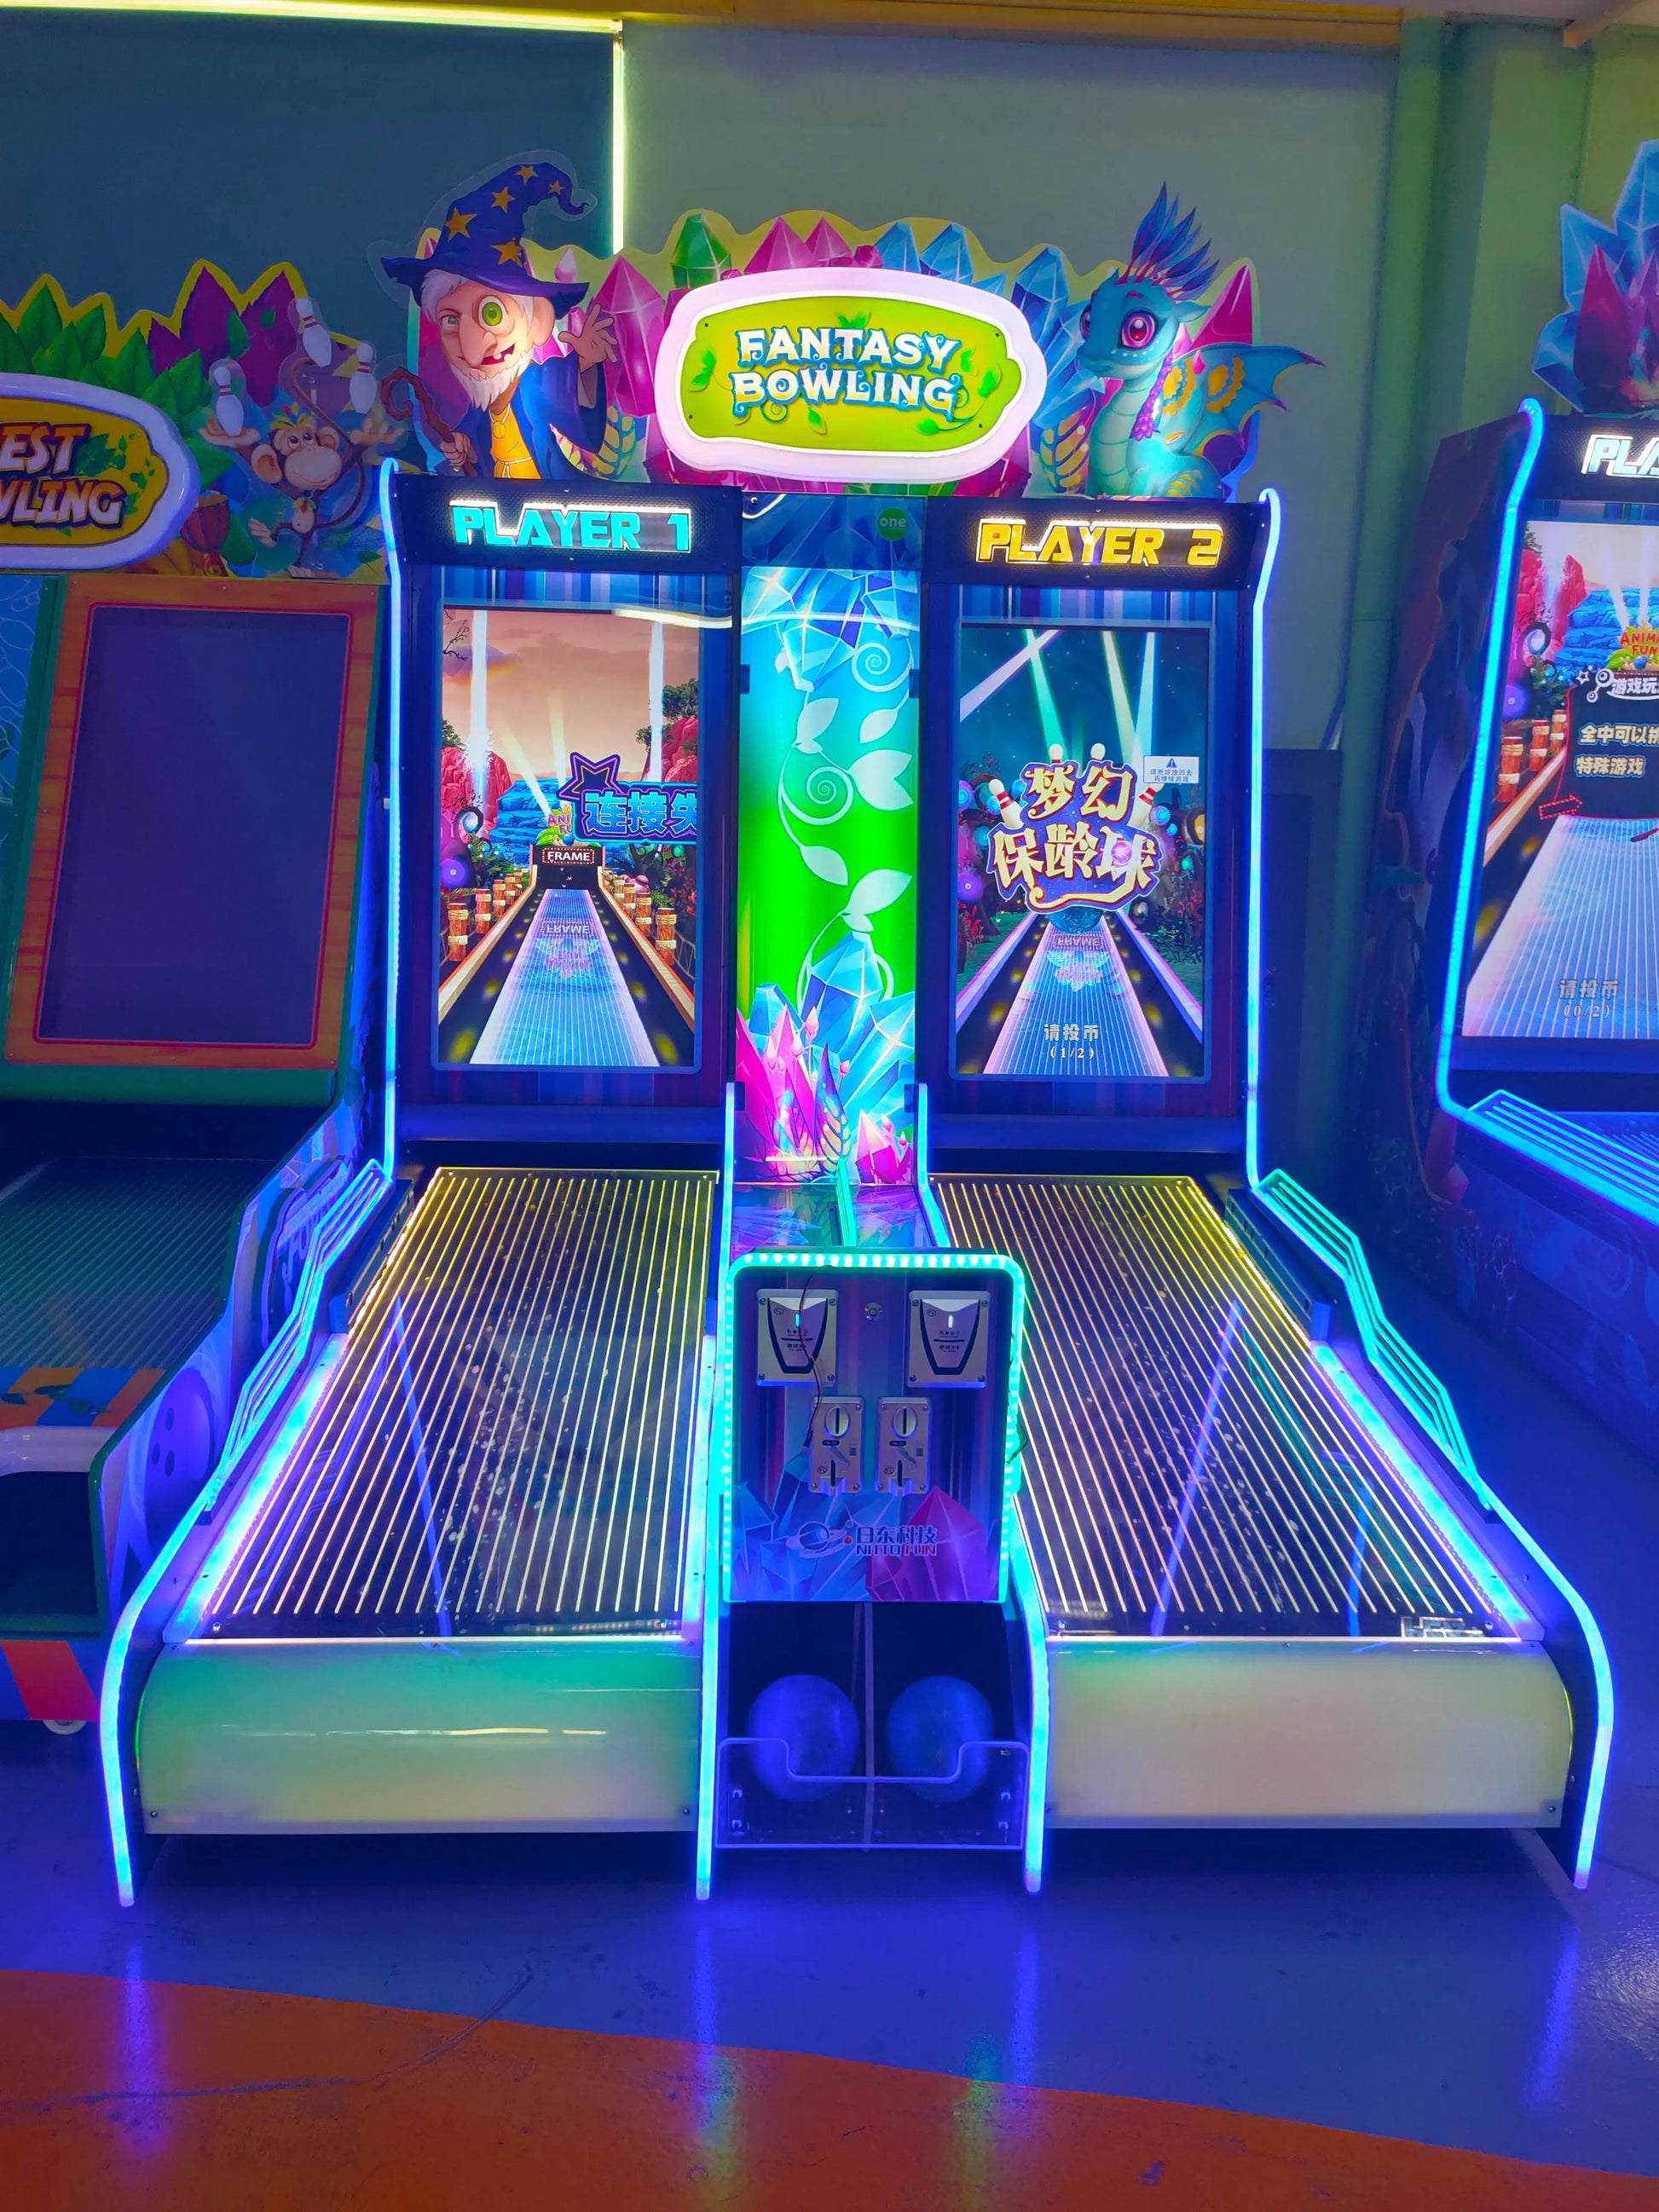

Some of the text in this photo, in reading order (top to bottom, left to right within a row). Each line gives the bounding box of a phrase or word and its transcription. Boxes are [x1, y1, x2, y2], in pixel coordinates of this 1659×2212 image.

[735, 326, 962, 373] FANTASY
[729, 363, 962, 421] BOWLING
[450, 501, 691, 552] PLAYER 1
[879, 517, 906, 528] one
[978, 521, 1223, 567] PLAYER 2
[1620, 631, 1659, 645] ANIM
[1612, 677, 1659, 695] 游戏玩
[1576, 756, 1645, 775] 特殊游戏
[1023, 764, 1134, 823] 梦幻
[547, 851, 591, 862] FRAME
[992, 821, 1158, 910] 保龄球
[1043, 1024, 1099, 1042] 请投币
[856, 1526, 937, 1545] 日东科技
